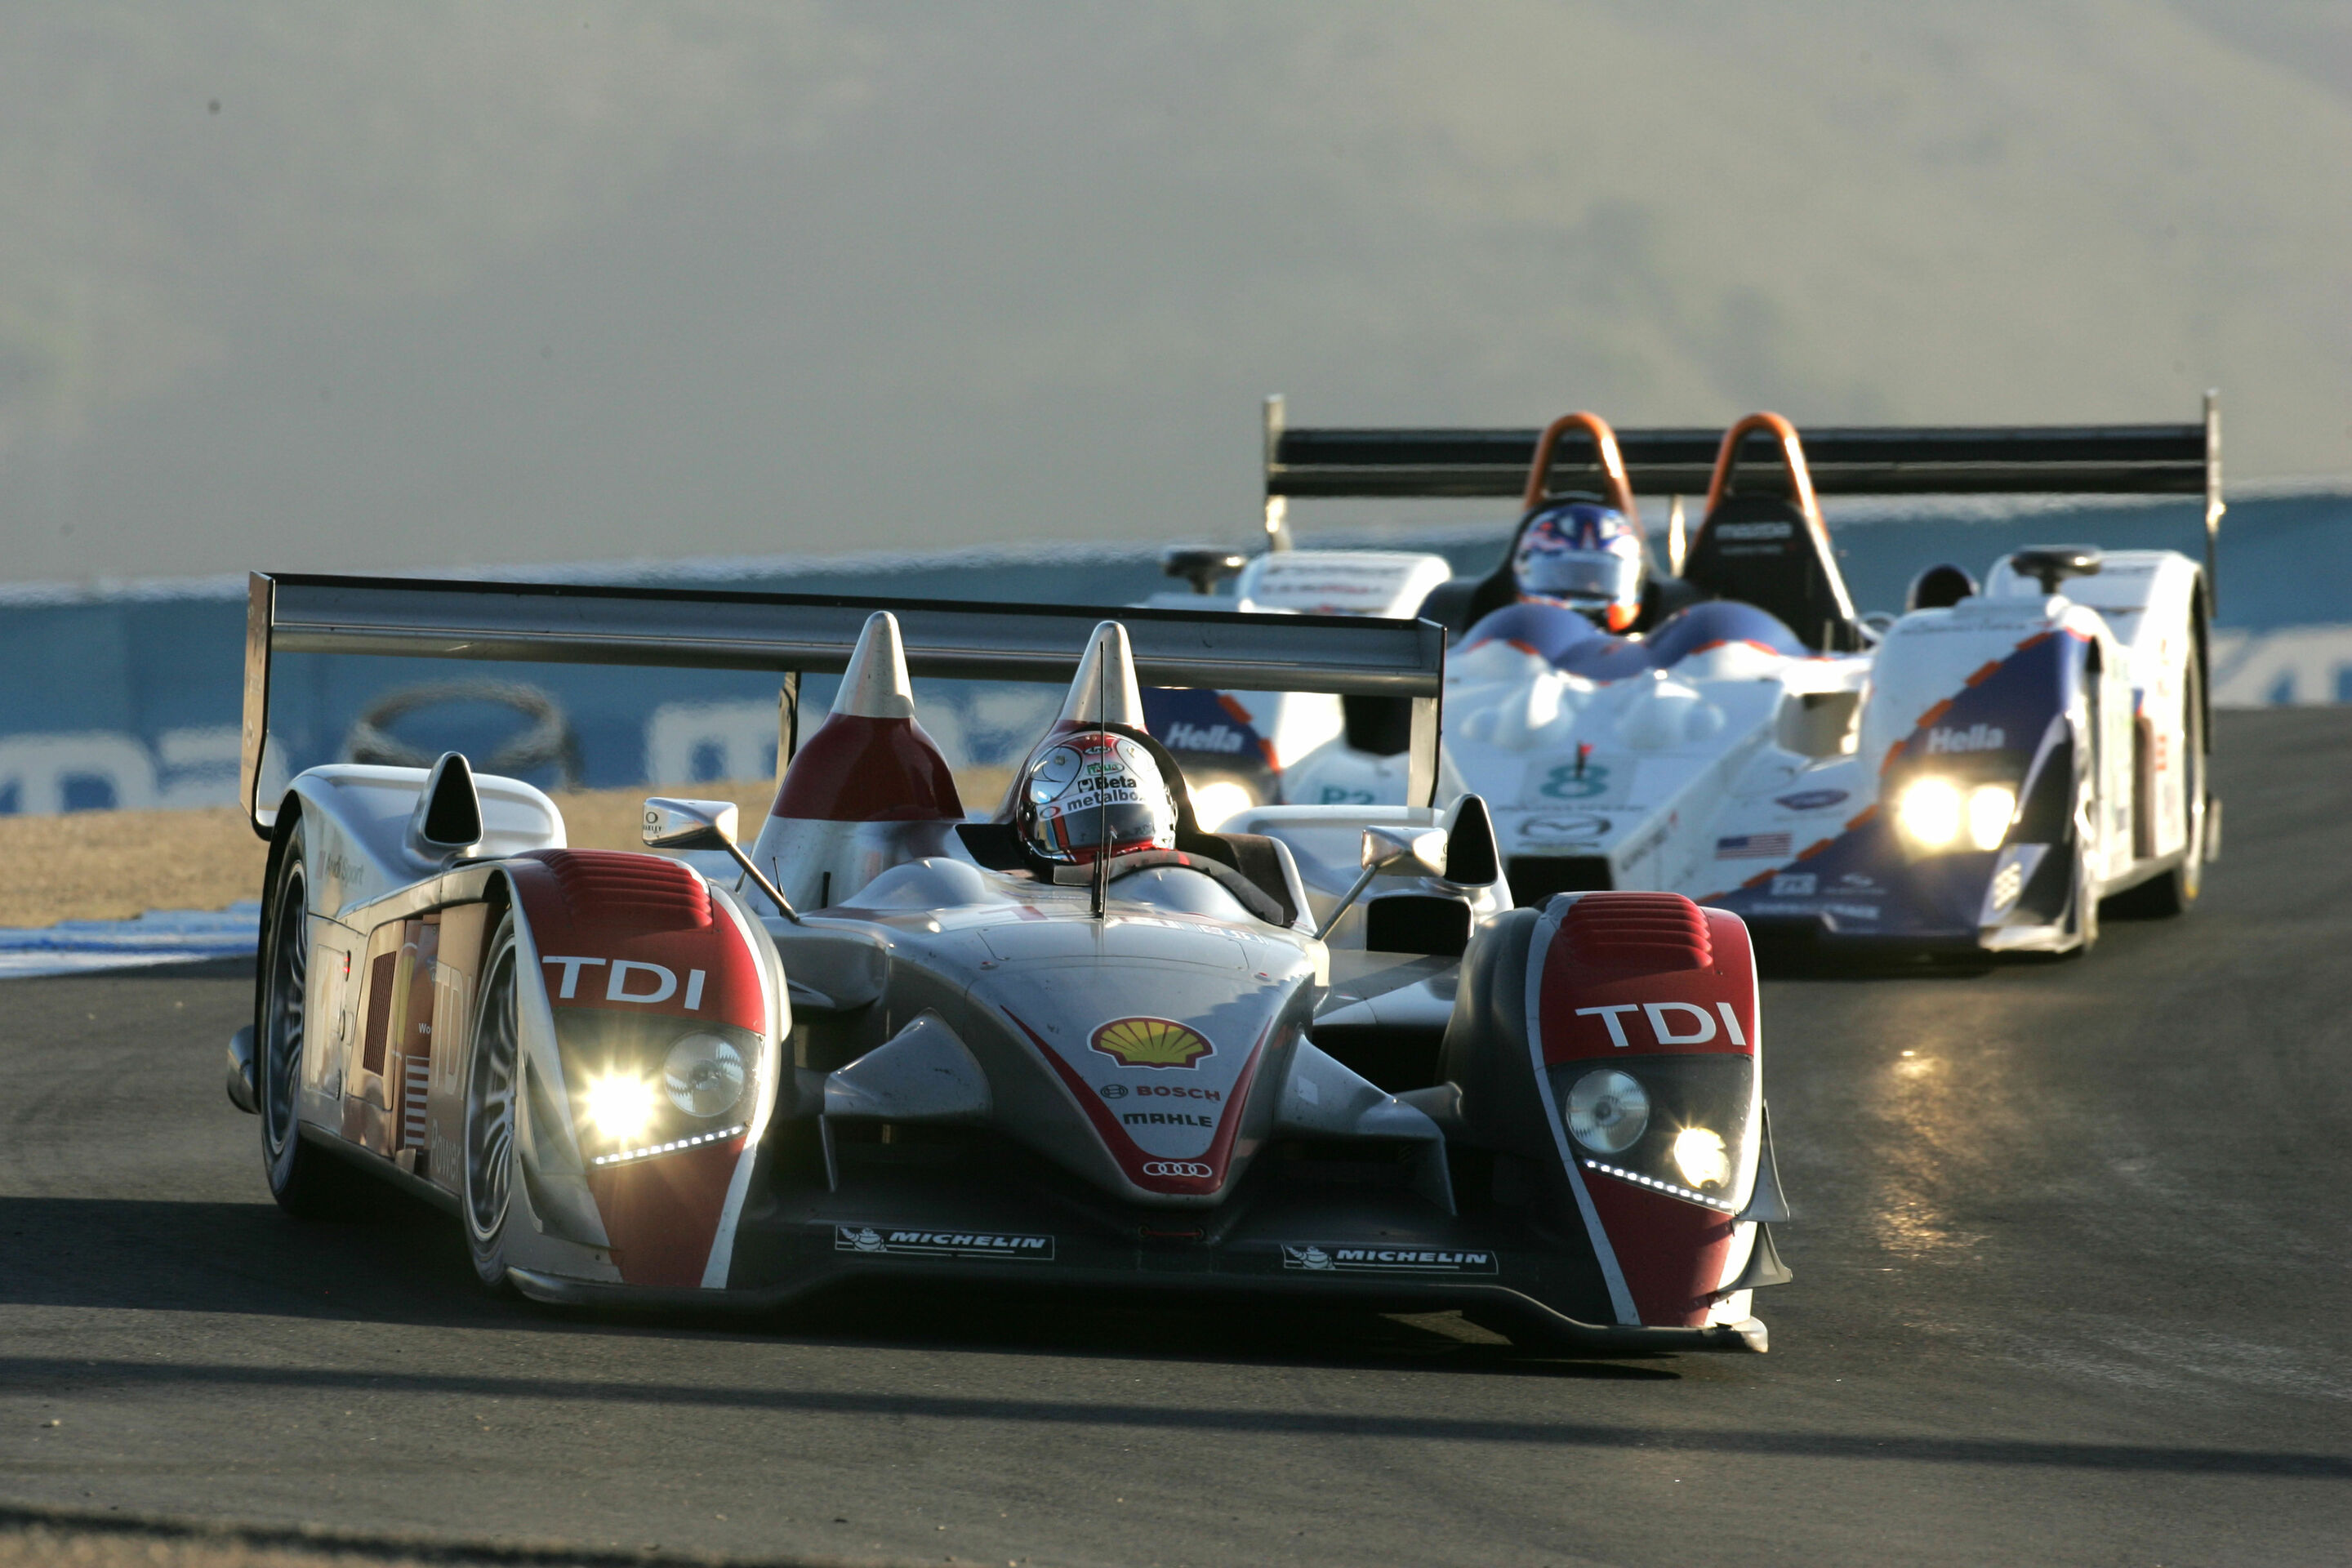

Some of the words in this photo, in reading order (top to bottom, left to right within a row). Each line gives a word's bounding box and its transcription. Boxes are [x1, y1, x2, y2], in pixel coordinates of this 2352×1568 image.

[1165, 721, 1245, 753] Hella
[1927, 723, 2006, 754] Hella
[1094, 775, 1137, 789] Beta
[1539, 764, 1611, 799] 8
[1067, 788, 1145, 811] metalbo
[325, 852, 342, 879] Audi
[341, 856, 365, 888] Sport
[542, 956, 706, 1011] TDI
[1575, 1001, 1747, 1048] TDI
[1136, 1085, 1221, 1102] BOSCH
[1123, 1112, 1214, 1128] MAHLE
[430, 1117, 462, 1183] Power
[889, 1232, 1046, 1249] MICHELIN
[1337, 1250, 1488, 1264] MICHELIN
